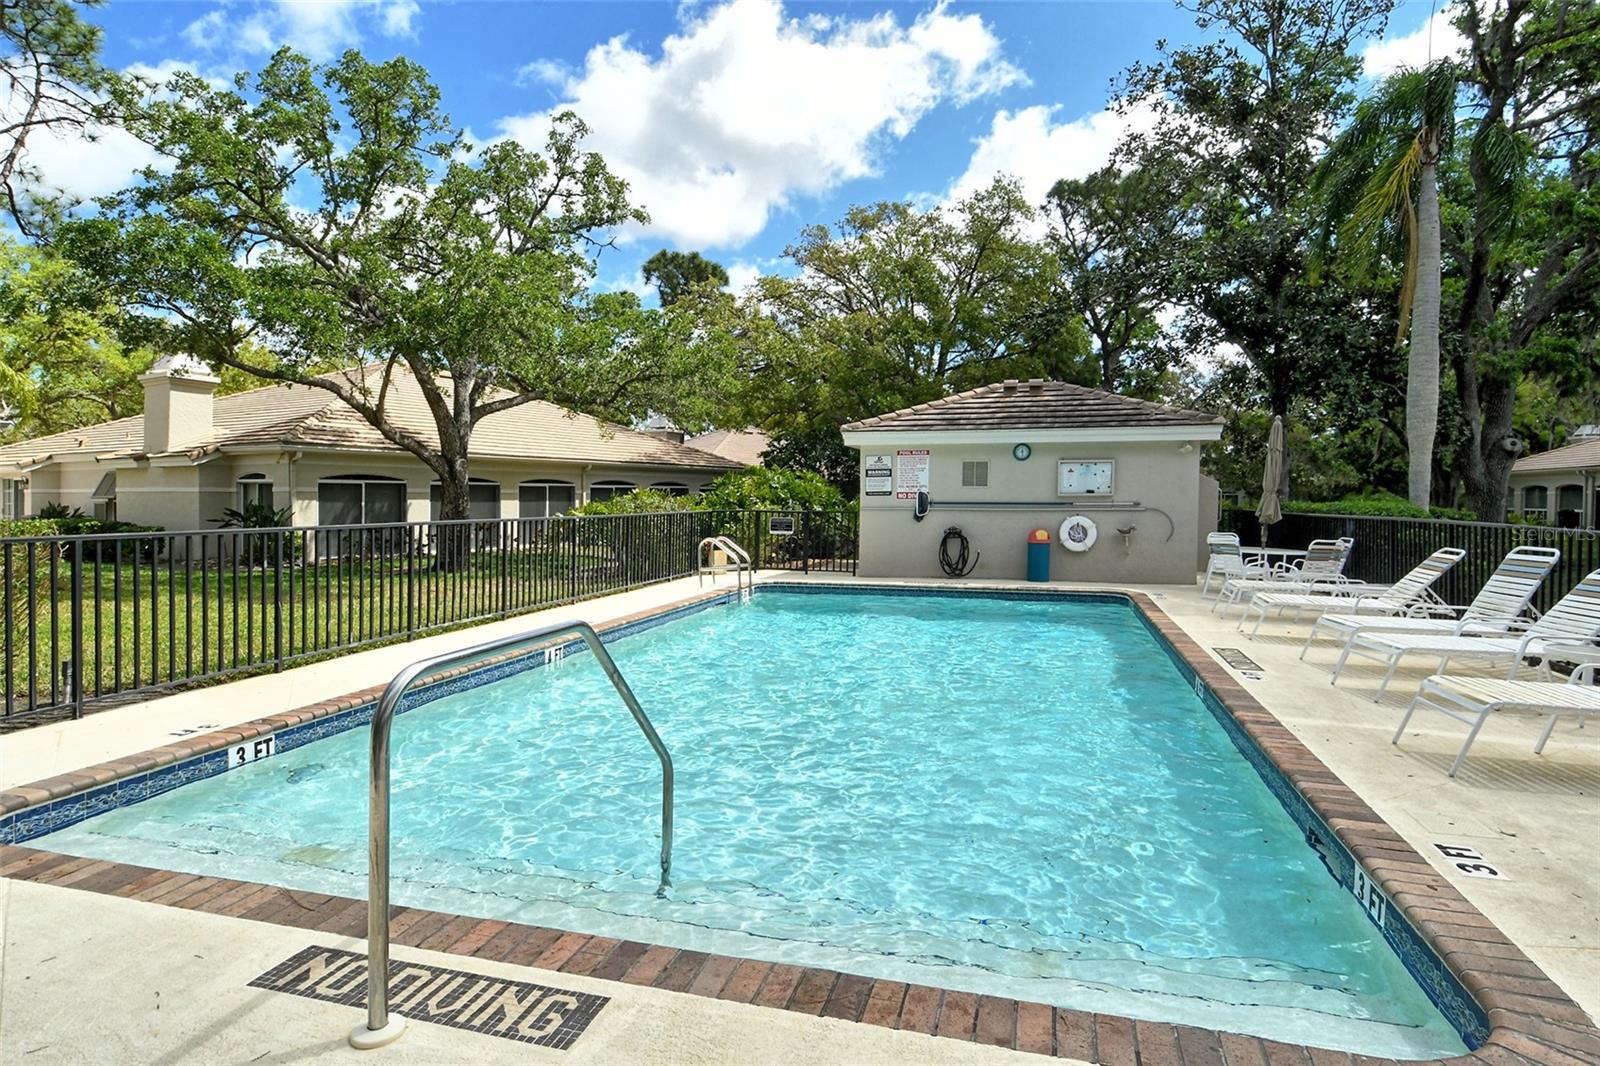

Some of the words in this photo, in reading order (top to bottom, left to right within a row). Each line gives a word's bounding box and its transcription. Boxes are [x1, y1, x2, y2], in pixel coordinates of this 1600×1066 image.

[236, 747, 246, 764] 3
[254, 737, 273, 759] FT
[1433, 843, 1483, 861] FT
[1455, 862, 1499, 877] 3
[1357, 872, 1366, 900] 3
[1368, 883, 1385, 924] FT
[277, 952, 372, 998] NO
